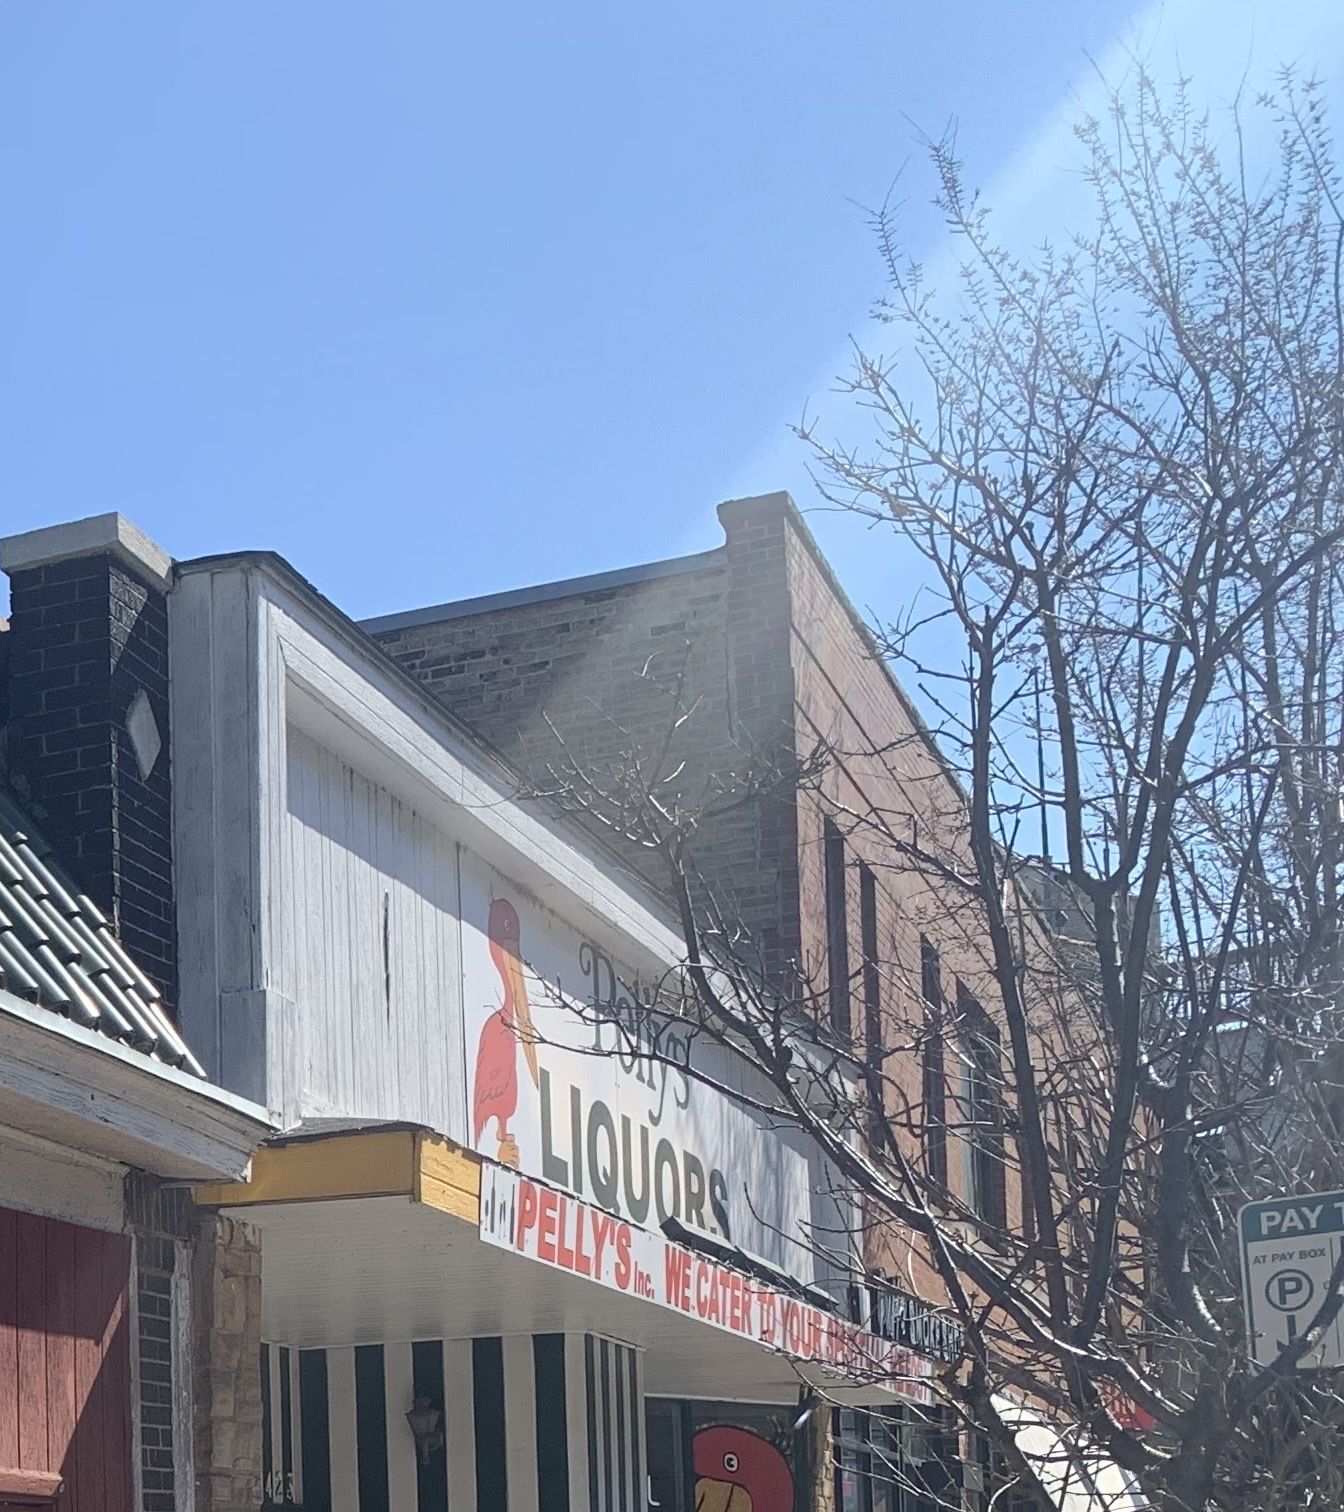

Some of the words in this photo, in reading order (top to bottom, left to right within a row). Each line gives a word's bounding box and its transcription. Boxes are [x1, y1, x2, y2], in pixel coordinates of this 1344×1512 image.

[539, 1066, 730, 1241] LIQUORS
[517, 1180, 631, 1290] PELLY'S
[635, 1261, 655, 1299] Inc.
[665, 1244, 691, 1312] WE
[697, 1261, 752, 1335] CATER
[757, 1287, 776, 1343] TO
[780, 1297, 822, 1358] YOUR
[1253, 1255, 1267, 1265] AT
[1272, 1251, 1295, 1263] PAY
[1299, 1247, 1326, 1259] BOX
[1260, 1204, 1324, 1235] PAY
